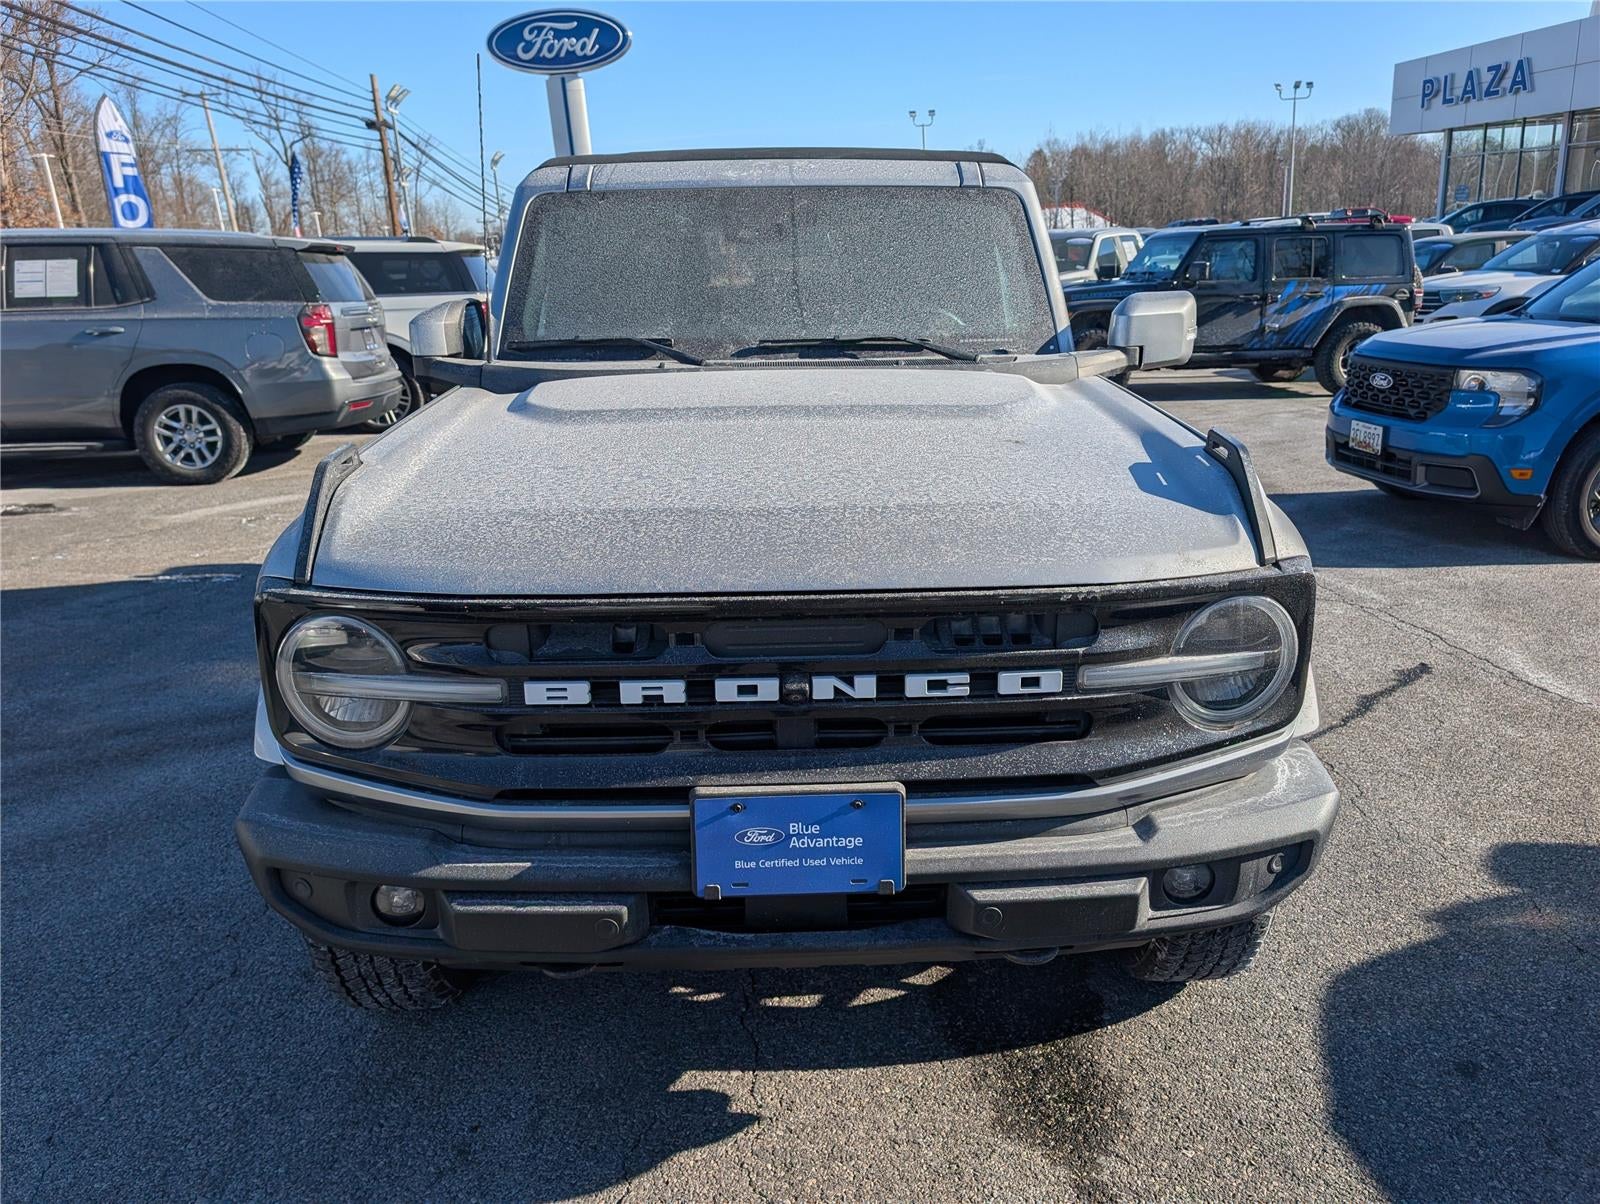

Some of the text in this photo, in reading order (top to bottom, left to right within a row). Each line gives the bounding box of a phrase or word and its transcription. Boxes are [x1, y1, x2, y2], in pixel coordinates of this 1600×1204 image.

[516, 21, 600, 60] Ford
[1420, 57, 1531, 110] PLAZA
[523, 670, 1064, 705] BRONCO
[789, 822, 820, 835] Blue
[743, 829, 775, 843] Ford
[789, 836, 863, 849] Advantage
[734, 856, 864, 869] Blue Certified Used Vehicle
